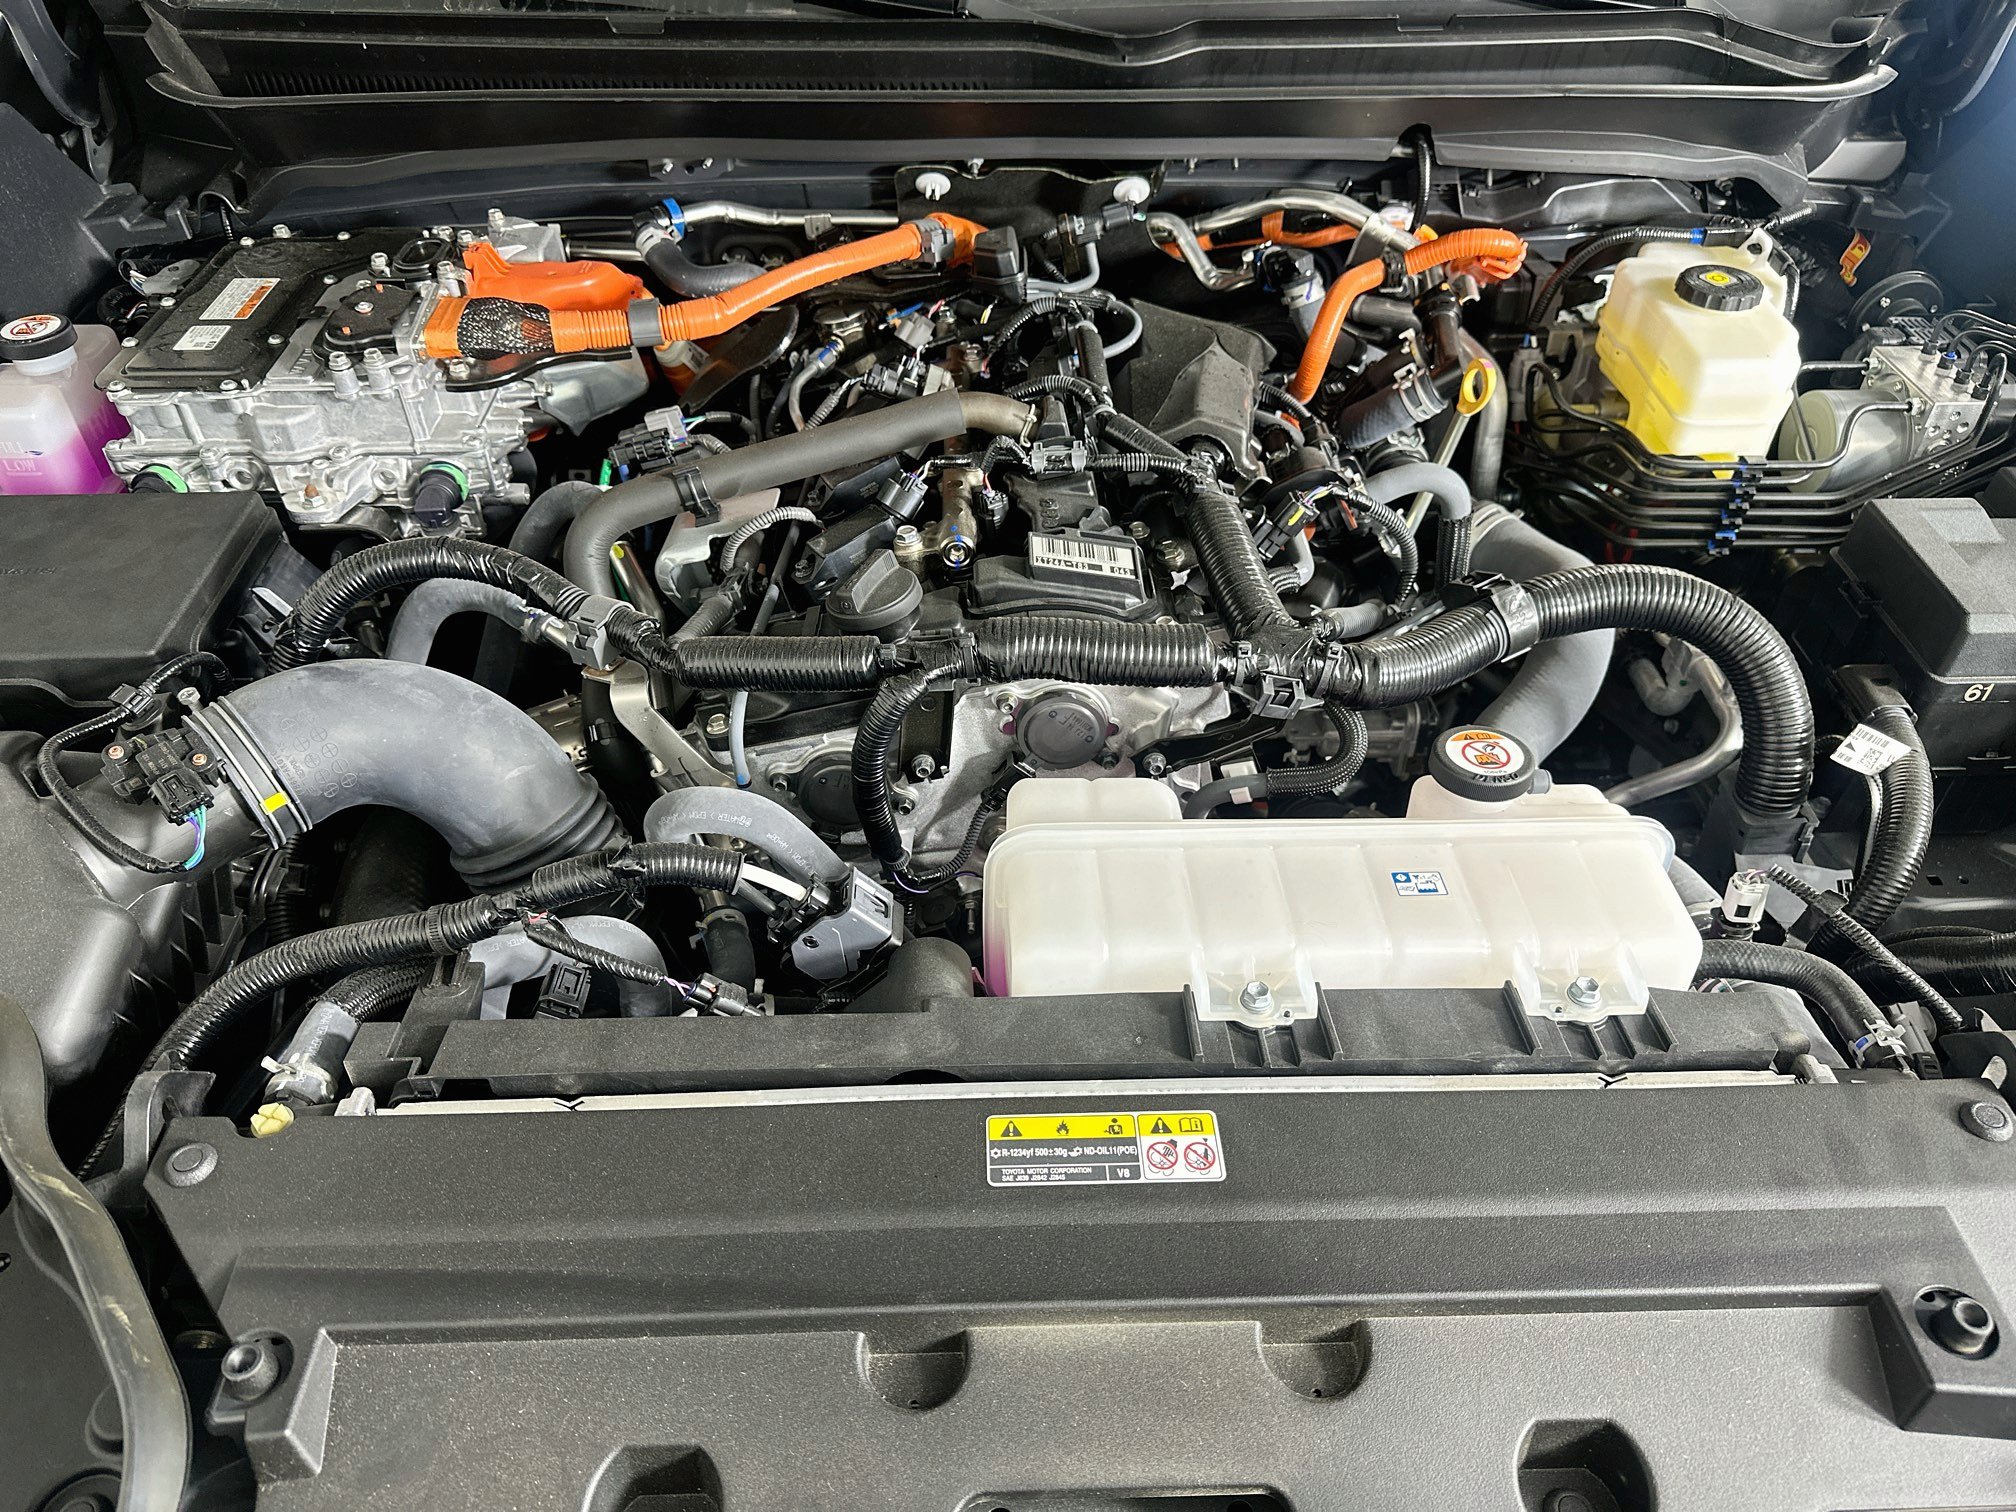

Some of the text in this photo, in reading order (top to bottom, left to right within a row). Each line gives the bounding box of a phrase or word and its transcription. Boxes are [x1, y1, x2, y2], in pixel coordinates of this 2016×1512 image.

[1113, 567, 1131, 576] 043
[1963, 683, 1995, 702] 61
[1002, 1145, 1138, 1158] R-1234yf 500±30g ND-OIL11(POE)
[1027, 1167, 1049, 1175] MOTOR
[1050, 1166, 1092, 1174] CORPORATION
